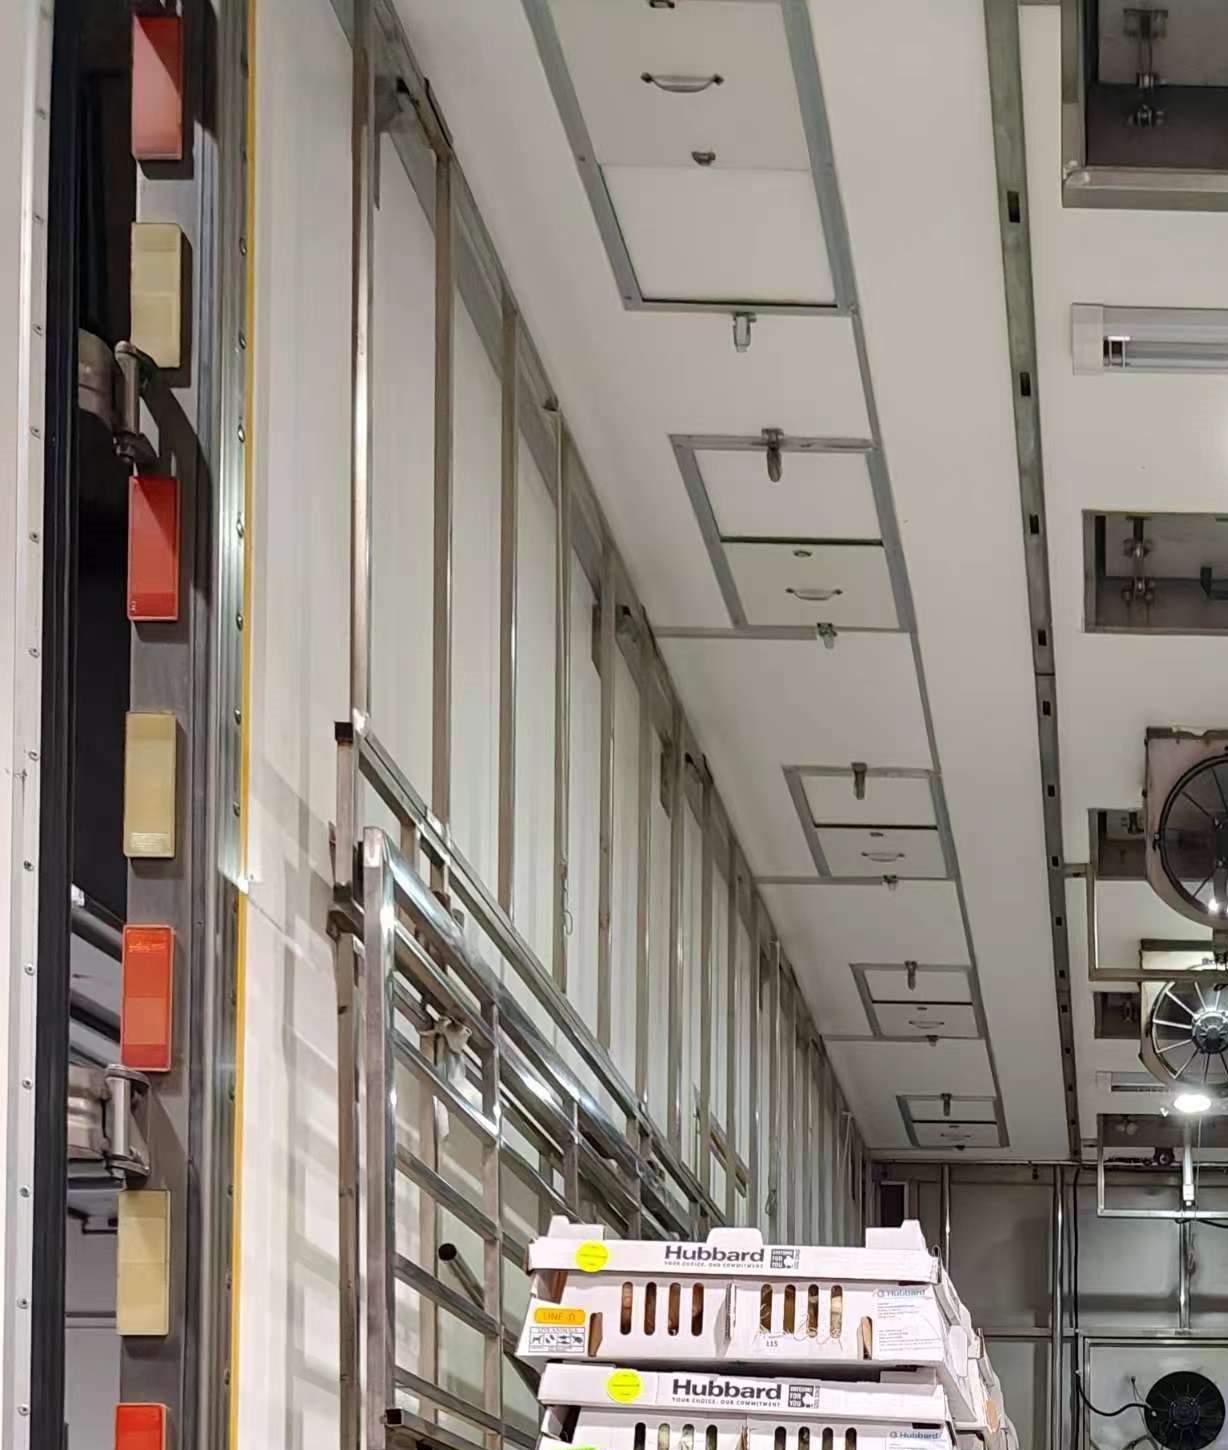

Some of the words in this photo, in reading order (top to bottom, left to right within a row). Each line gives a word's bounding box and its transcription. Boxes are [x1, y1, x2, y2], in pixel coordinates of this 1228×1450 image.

[665, 1245, 765, 1262] Hubbard
[543, 1312, 562, 1321] LINE
[673, 1379, 782, 1400] Hubbard
